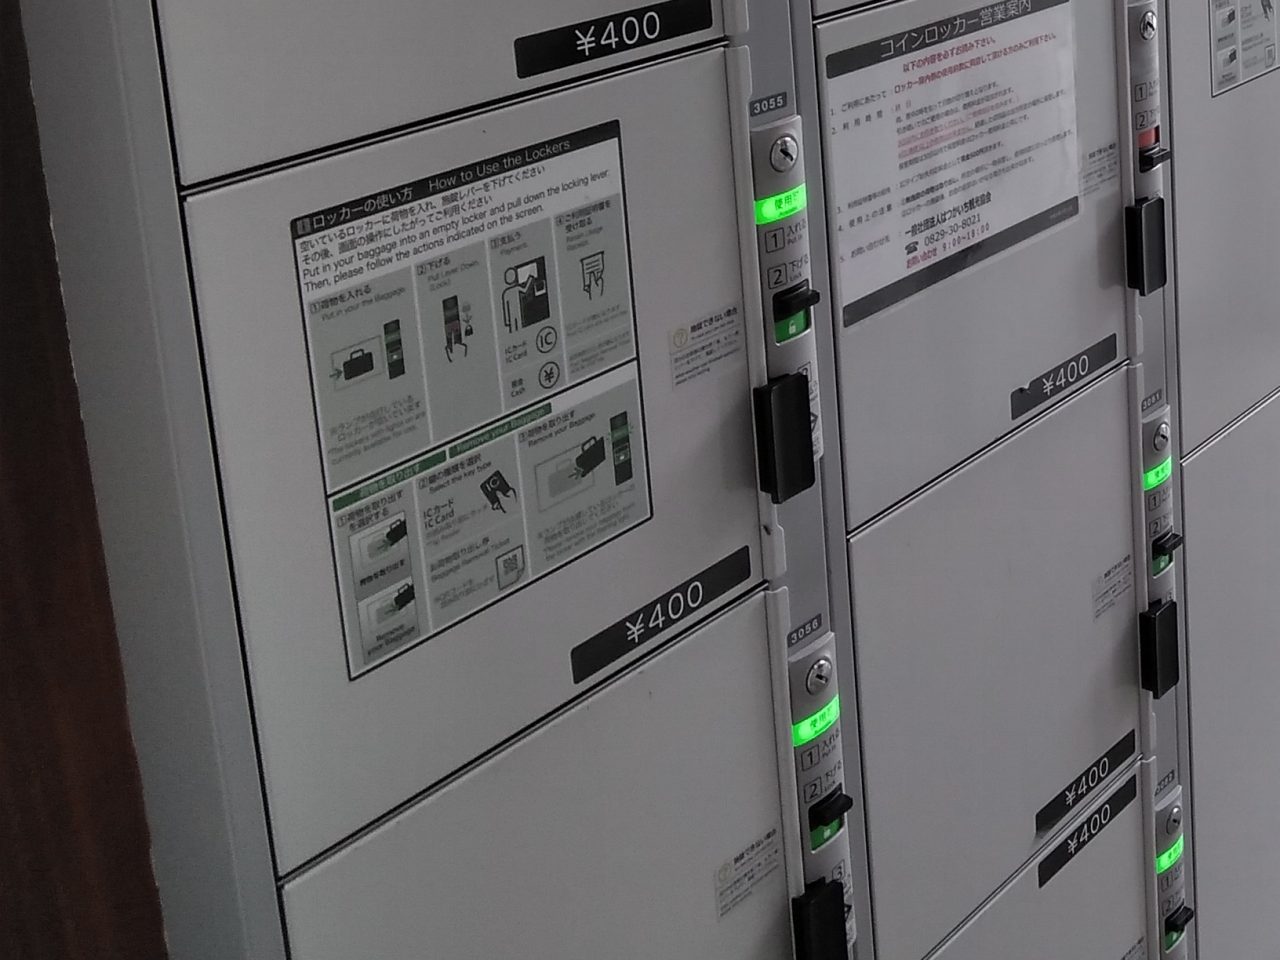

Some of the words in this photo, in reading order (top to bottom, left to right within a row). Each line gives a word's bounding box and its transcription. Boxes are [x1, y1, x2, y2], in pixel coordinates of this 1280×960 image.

[575, 11, 660, 56] ¥400
[753, 95, 784, 114] 3055
[312, 187, 412, 228] ロッカーの使い方
[429, 176, 457, 192] How
[461, 170, 473, 181] to
[476, 162, 499, 177] Use
[502, 155, 522, 169] the
[525, 139, 571, 162] Lockers
[303, 266, 320, 279] Put
[322, 263, 331, 273] in
[333, 255, 354, 272] your
[357, 240, 397, 261] baggage
[401, 232, 417, 245] into
[419, 229, 430, 239] an
[432, 217, 459, 236] empty
[462, 210, 487, 225] locker
[490, 202, 505, 213] and
[507, 197, 522, 212] pull
[524, 191, 546, 205] down
[547, 185, 560, 197] the
[561, 176, 589, 191] locking
[333, 265, 364, 284] please
[366, 256, 393, 272] follow
[395, 250, 410, 261] the
[413, 237, 445, 255] actions
[446, 223, 485, 243] indicated
[487, 219, 498, 229] on
[500, 214, 513, 225] the
[924, 213, 982, 247] 0829-30-8021
[1042, 354, 1089, 396] ¥400
[435, 509, 454, 524] Card
[625, 581, 703, 643] ¥400
[791, 620, 819, 643] 3056
[1065, 756, 1109, 806] ¥400
[1067, 804, 1111, 854] ¥400
